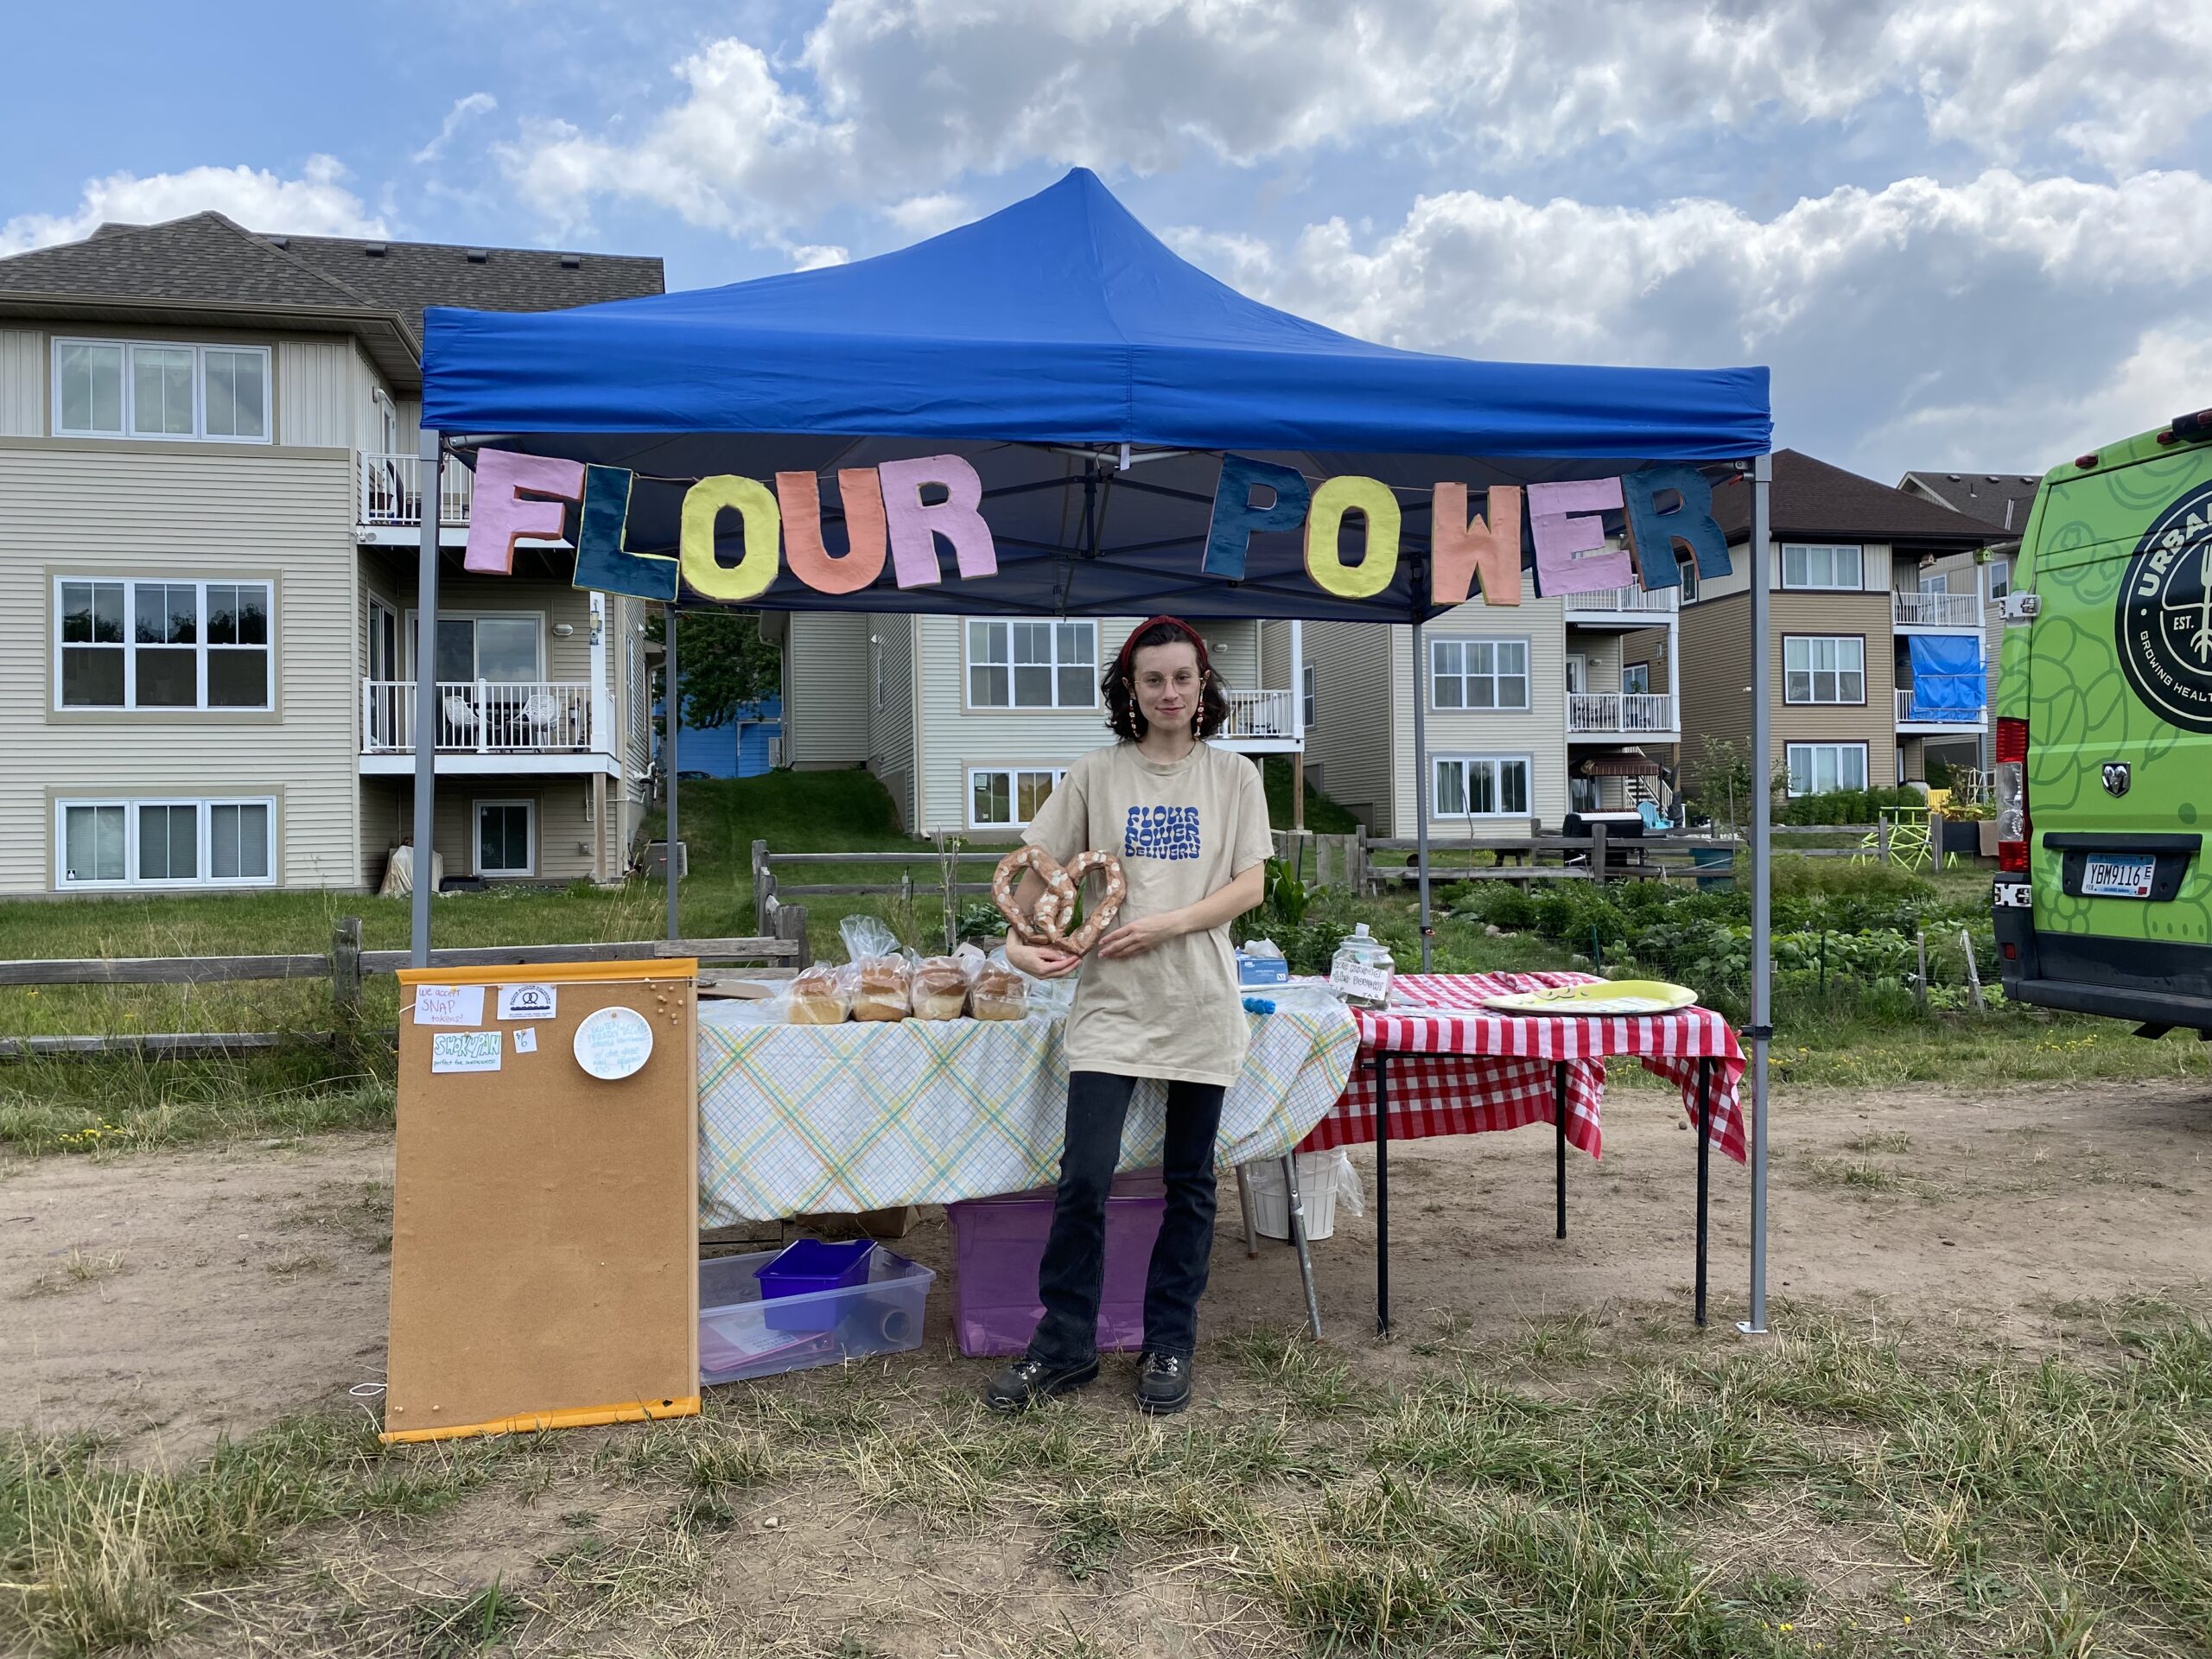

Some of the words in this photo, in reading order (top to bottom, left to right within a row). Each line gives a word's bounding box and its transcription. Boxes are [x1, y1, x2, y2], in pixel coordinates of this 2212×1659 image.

[464, 448, 998, 603] FLOUR
[1202, 454, 1732, 607] POWER
[2173, 616, 2195, 631] EST.
[2140, 630, 2173, 686] GROWING
[1128, 805, 1199, 828] FLOUR
[1125, 823, 1200, 846] POWER
[1125, 843, 1200, 861] DELIVERY
[2090, 864, 2141, 886] YBM9116
[2145, 867, 2152, 877] E
[422, 999, 455, 1014] SNAP
[429, 1014, 463, 1023] tokens!
[516, 1033, 528, 1047] $6
